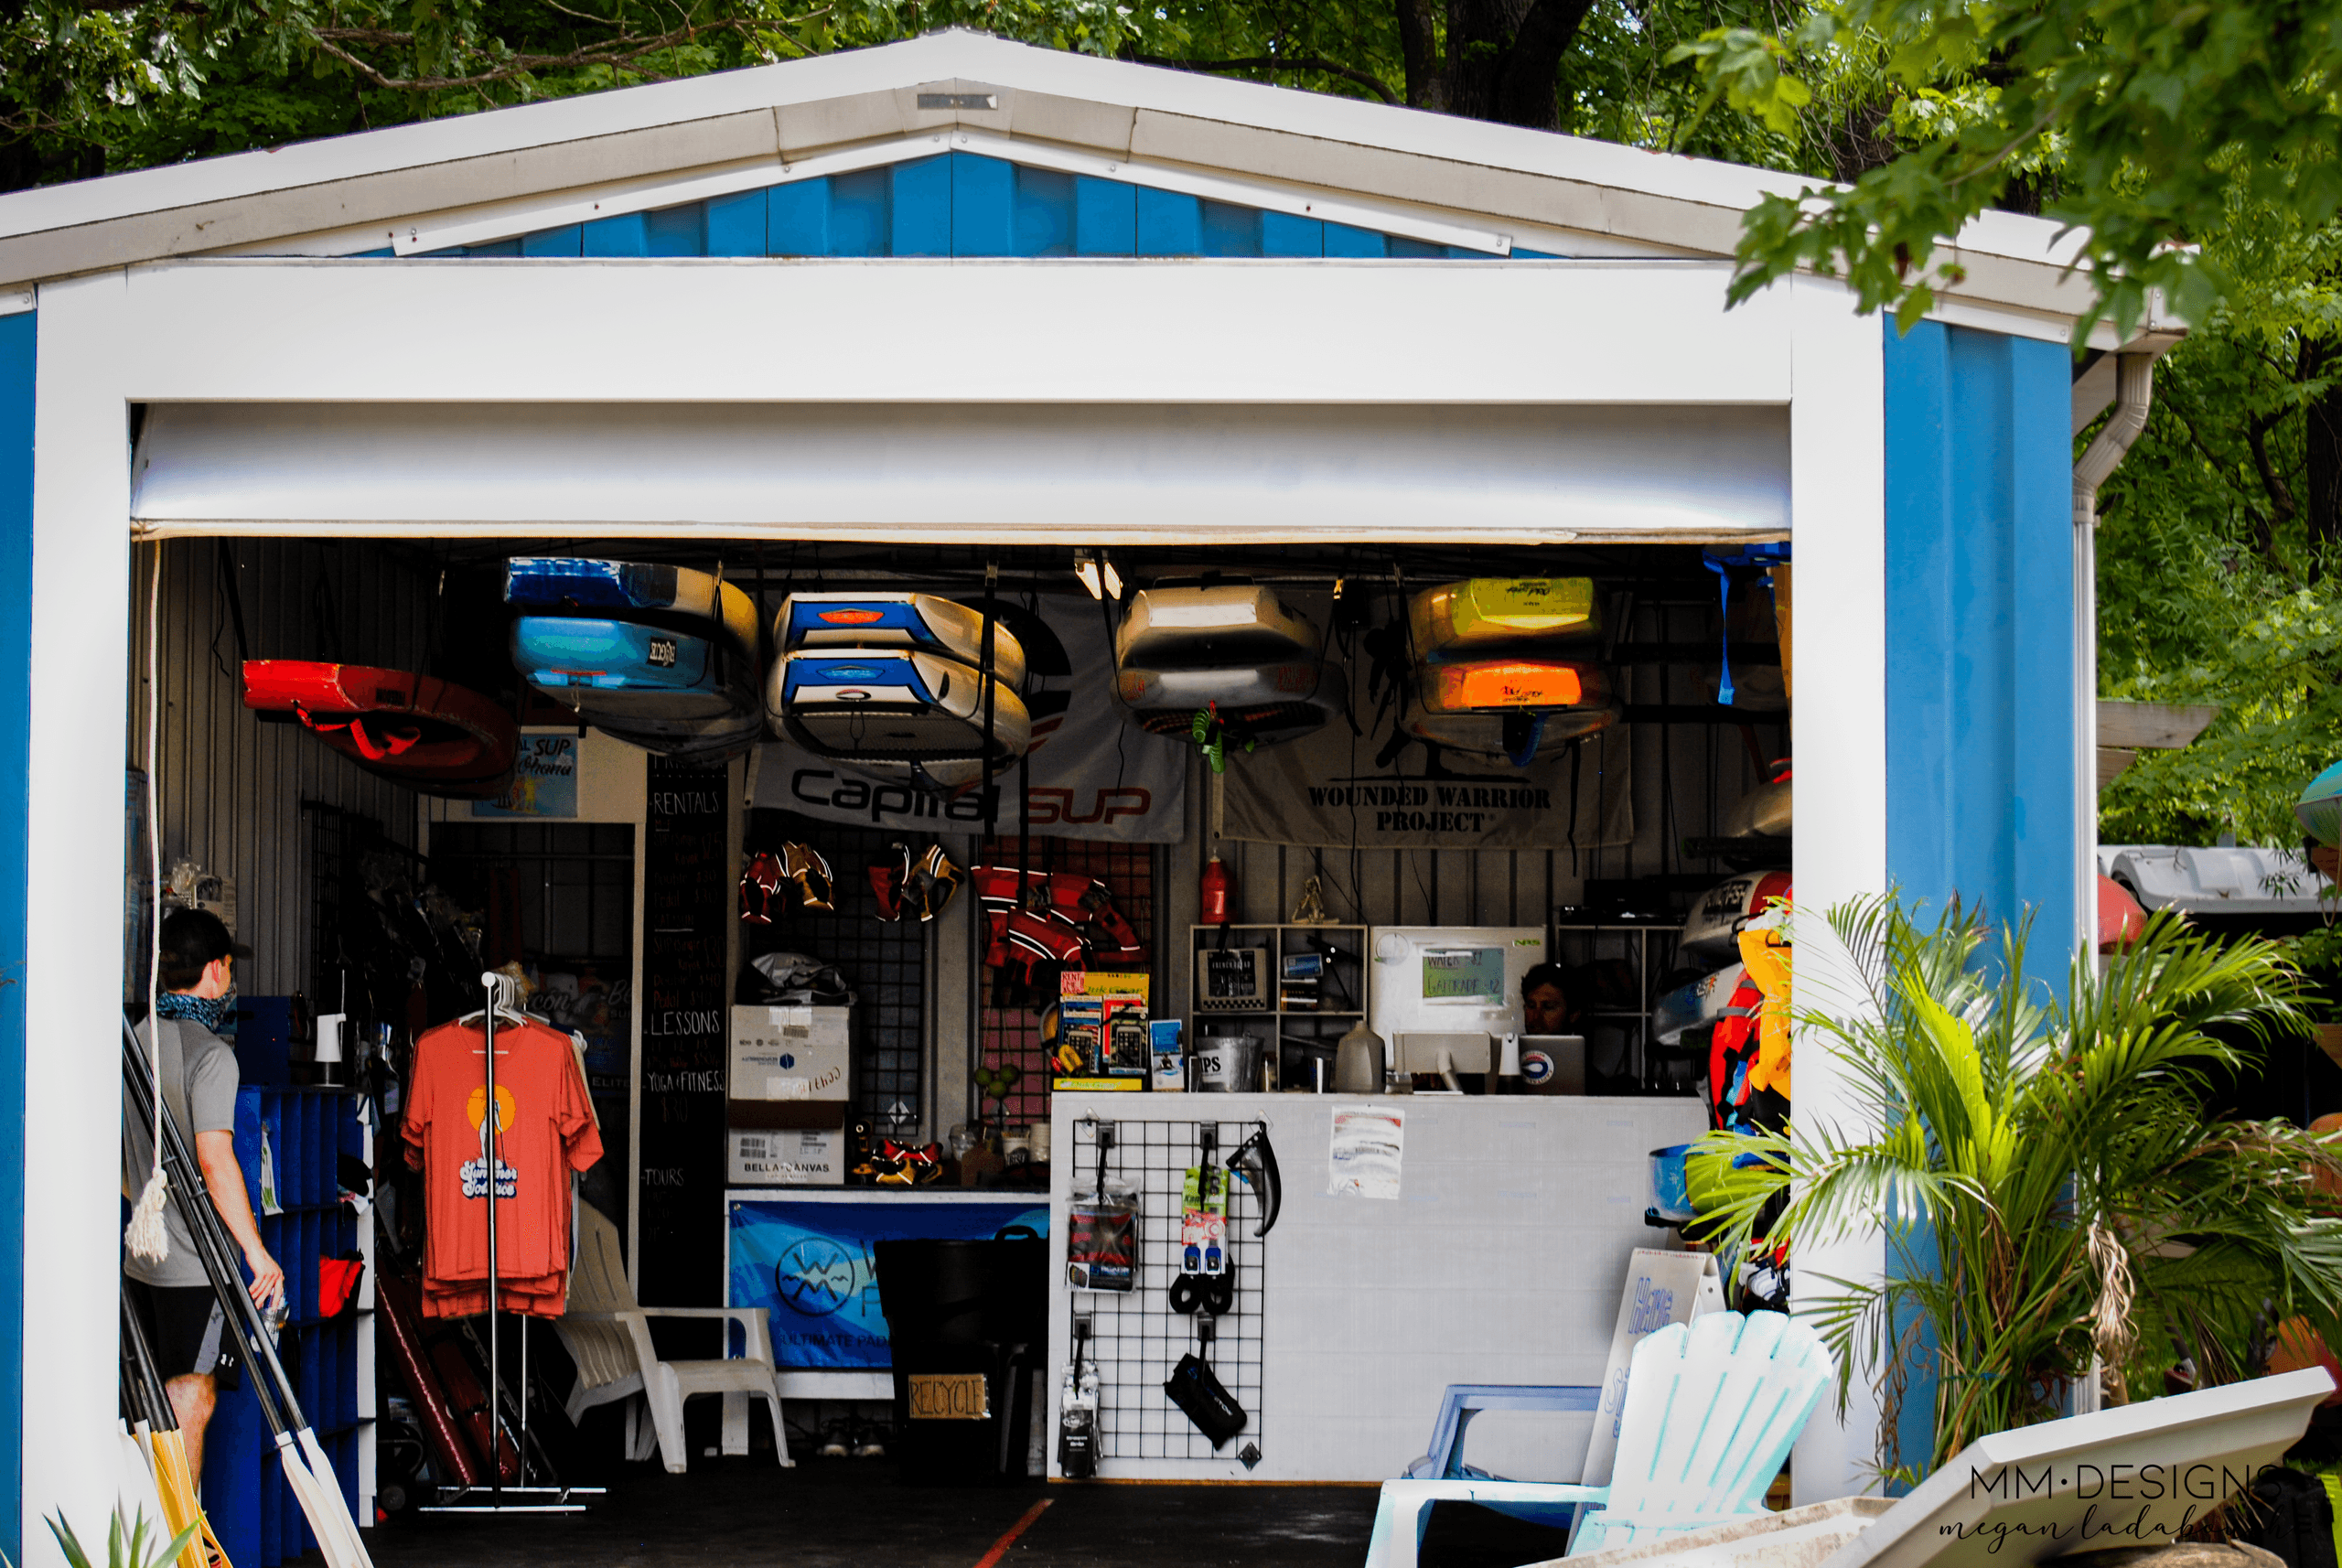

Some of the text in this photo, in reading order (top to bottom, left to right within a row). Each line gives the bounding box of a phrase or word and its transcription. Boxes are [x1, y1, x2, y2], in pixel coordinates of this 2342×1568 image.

[533, 739, 571, 756] SUP
[653, 790, 720, 816] RENTALS
[1026, 787, 1152, 824] SUP
[1308, 787, 1552, 809] WOUNDED WARRIOR
[1377, 811, 1486, 832] PROJECT
[650, 1009, 721, 1036] LESSONS
[1199, 1056, 1221, 1073] IPS
[647, 1070, 674, 1094] YOGA
[680, 1069, 726, 1093] FITNESS
[643, 1166, 685, 1187] TOURS
[909, 1380, 983, 1416] RECYCLE
